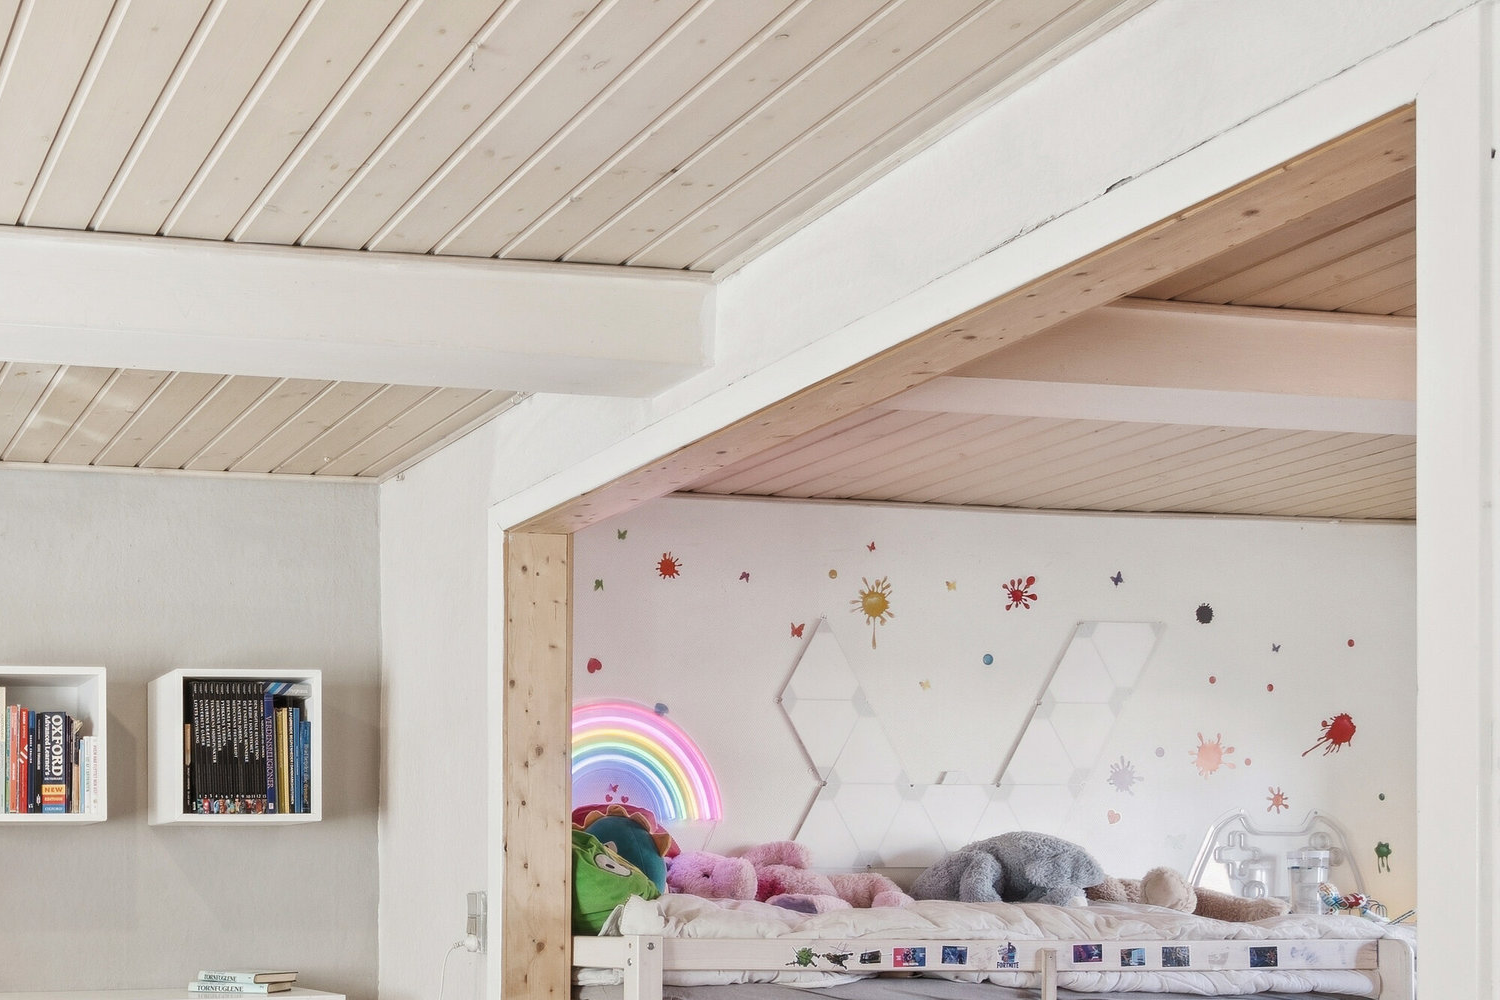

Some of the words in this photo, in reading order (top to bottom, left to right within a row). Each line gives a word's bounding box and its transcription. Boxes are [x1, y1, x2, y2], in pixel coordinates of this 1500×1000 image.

[51, 714, 63, 777] OXFORD
[265, 715, 274, 789] VERDENSRELIGIONER
[996, 961, 1019, 969] FORTNITE
[204, 974, 237, 982] TORNFUGLENE
[197, 985, 244, 993] TORNFUGLENE
